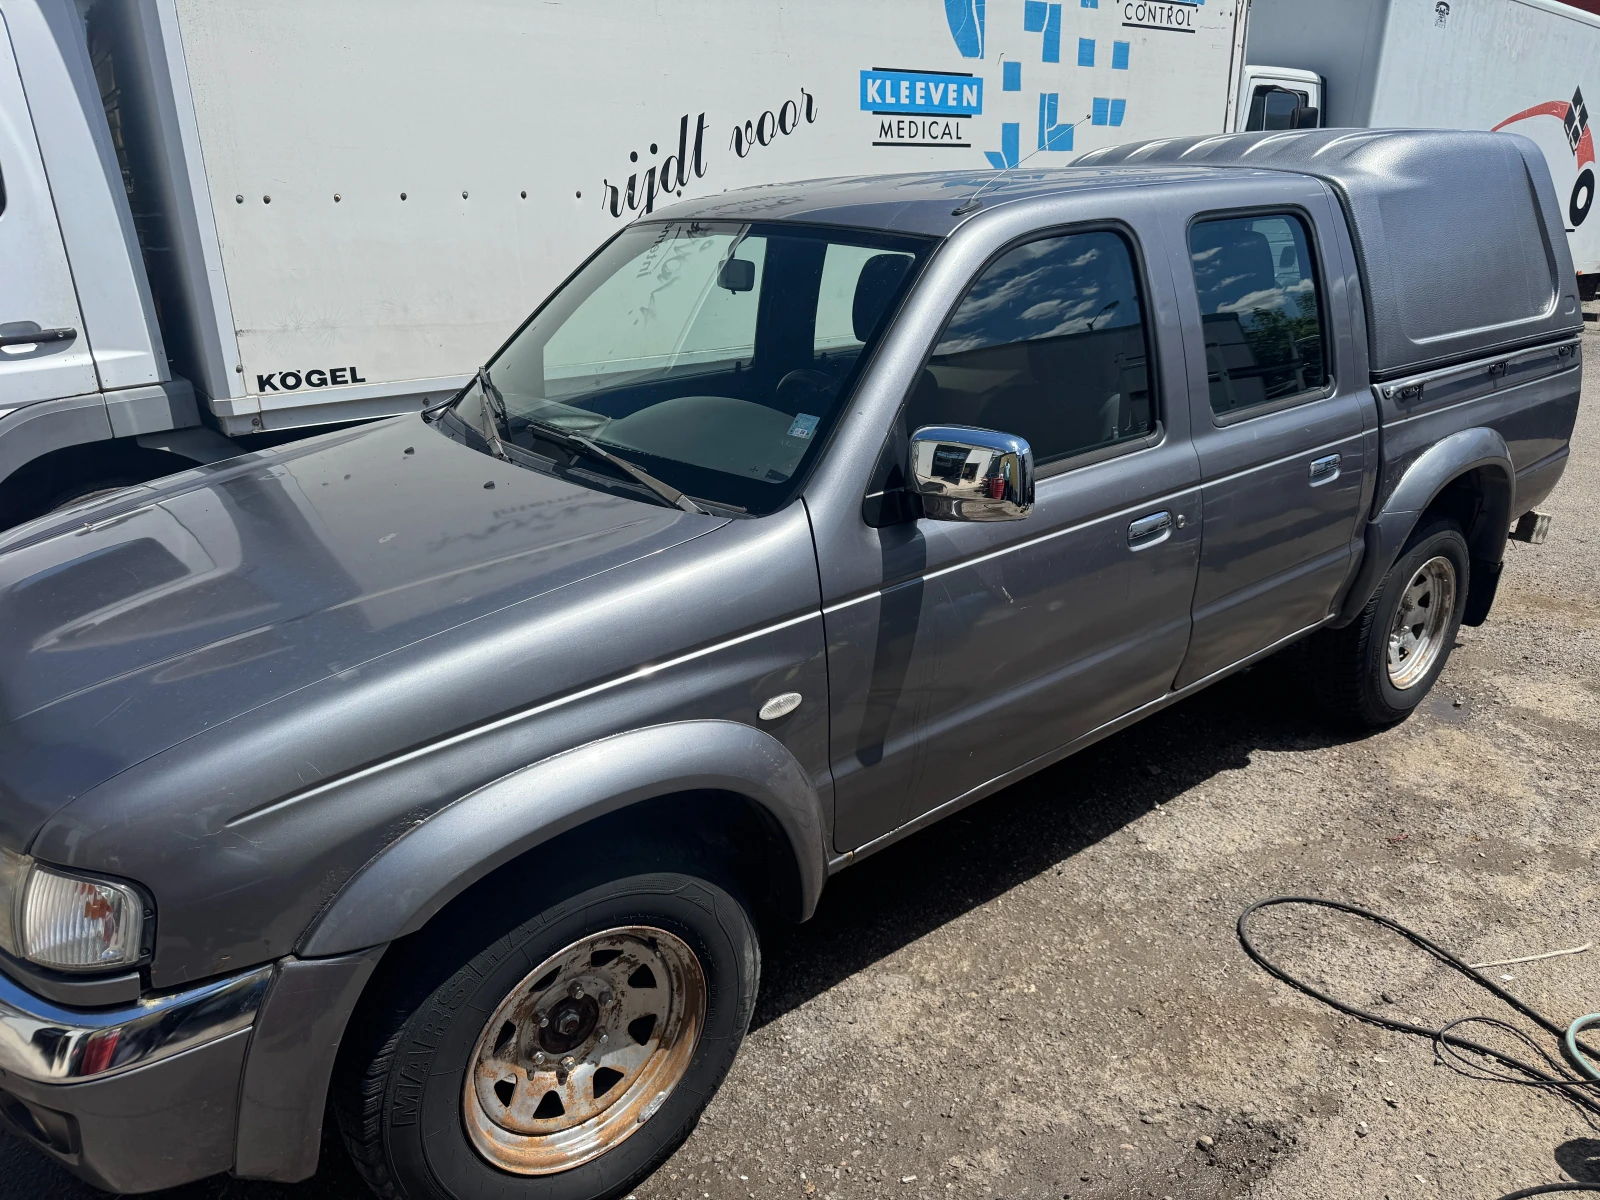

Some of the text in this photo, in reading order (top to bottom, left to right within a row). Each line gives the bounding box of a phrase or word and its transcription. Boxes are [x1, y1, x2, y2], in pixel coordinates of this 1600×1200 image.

[1124, 2, 1191, 27] CONTROL
[866, 78, 979, 107] KLEEVEN
[878, 119, 963, 140] MEDICAL
[601, 86, 819, 219] rijdt voor
[256, 366, 366, 393] KÖGEL
[391, 904, 568, 1127] MARSHAL
